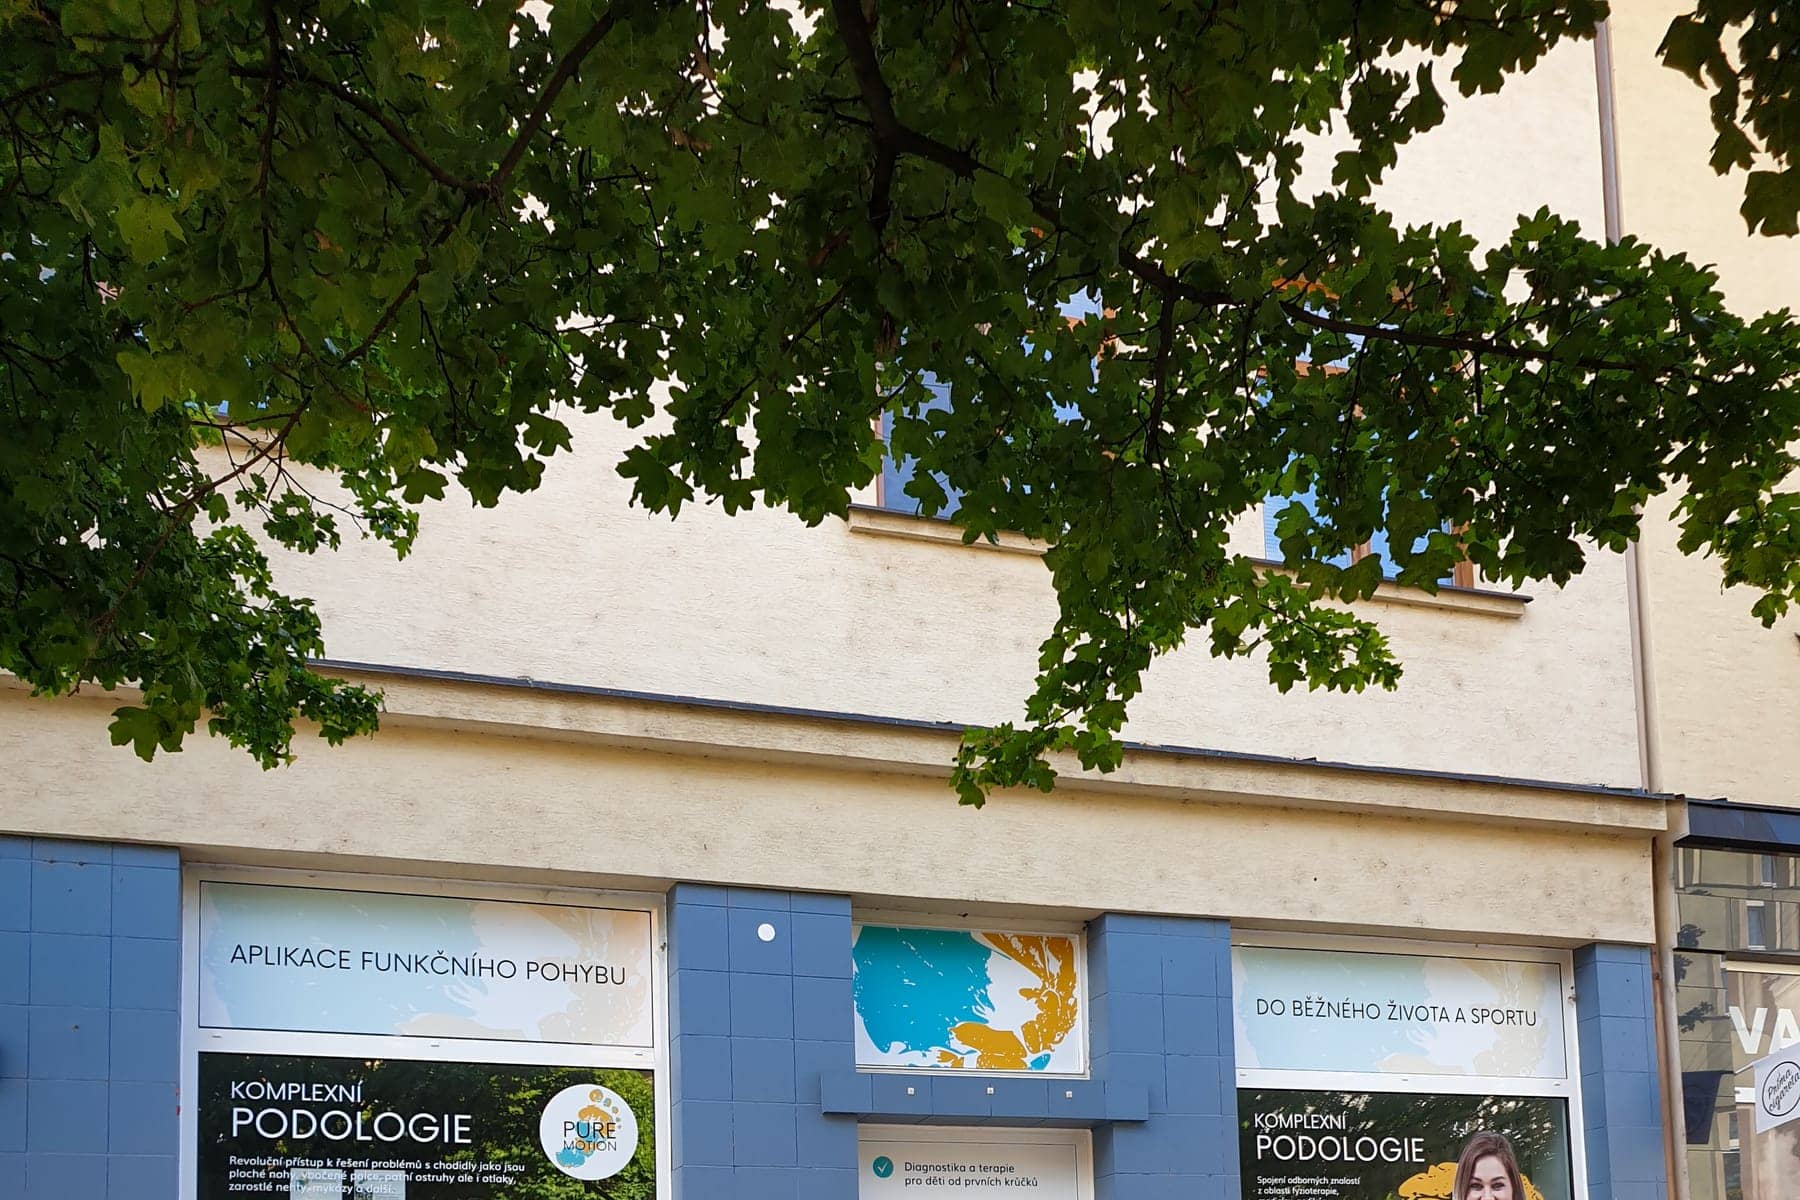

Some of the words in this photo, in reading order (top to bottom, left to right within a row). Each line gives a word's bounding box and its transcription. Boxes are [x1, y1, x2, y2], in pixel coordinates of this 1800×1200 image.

[230, 943, 351, 970] APLIKACE
[361, 950, 517, 980] FUNKČNÍHO
[527, 961, 627, 986] POHYBU
[1256, 998, 1285, 1016] DO
[1292, 995, 1381, 1020] BĚŽNÉHO
[1387, 999, 1450, 1023] ŽIVOTA
[1455, 1007, 1466, 1023] A
[1471, 1007, 1537, 1027] SPORTU
[231, 1080, 364, 1102] KOMPLEXNÍ
[232, 1108, 472, 1144] PODOLOGIE
[1254, 1111, 1347, 1130] KOMPLEXNÍ
[563, 1121, 616, 1139] PURE
[563, 1140, 617, 1151] MOTION
[1256, 1135, 1425, 1162] PODOLOGIE
[229, 1155, 283, 1166] Revoluční
[286, 1157, 324, 1168] přístup
[327, 1158, 333, 1167] k
[336, 1158, 370, 1168] řešení
[371, 1159, 422, 1170] problémů
[434, 1160, 477, 1172] chodidly
[478, 1161, 501, 1172] jako
[504, 1162, 525, 1173] jsou
[904, 1162, 966, 1174] Diagnostika
[969, 1164, 976, 1172] a
[979, 1163, 1015, 1175] terapie
[229, 1169, 265, 1179] ploché
[416, 1173, 454, 1184] ostruhy
[457, 1173, 473, 1183] ale
[482, 1174, 516, 1185] otlaky,
[905, 1177, 922, 1187] pro
[925, 1176, 945, 1186] děti
[948, 1176, 962, 1186] od
[965, 1176, 1001, 1188] prvních
[1004, 1177, 1038, 1187] krůčků
[1256, 1176, 1286, 1185] Spojení
[1287, 1176, 1329, 1185] odborných
[1330, 1177, 1361, 1185] znalostí
[229, 1182, 273, 1191] zarostlé
[1263, 1186, 1291, 1195] oblasti
[1292, 1187, 1339, 1196] fyzioterapie,
